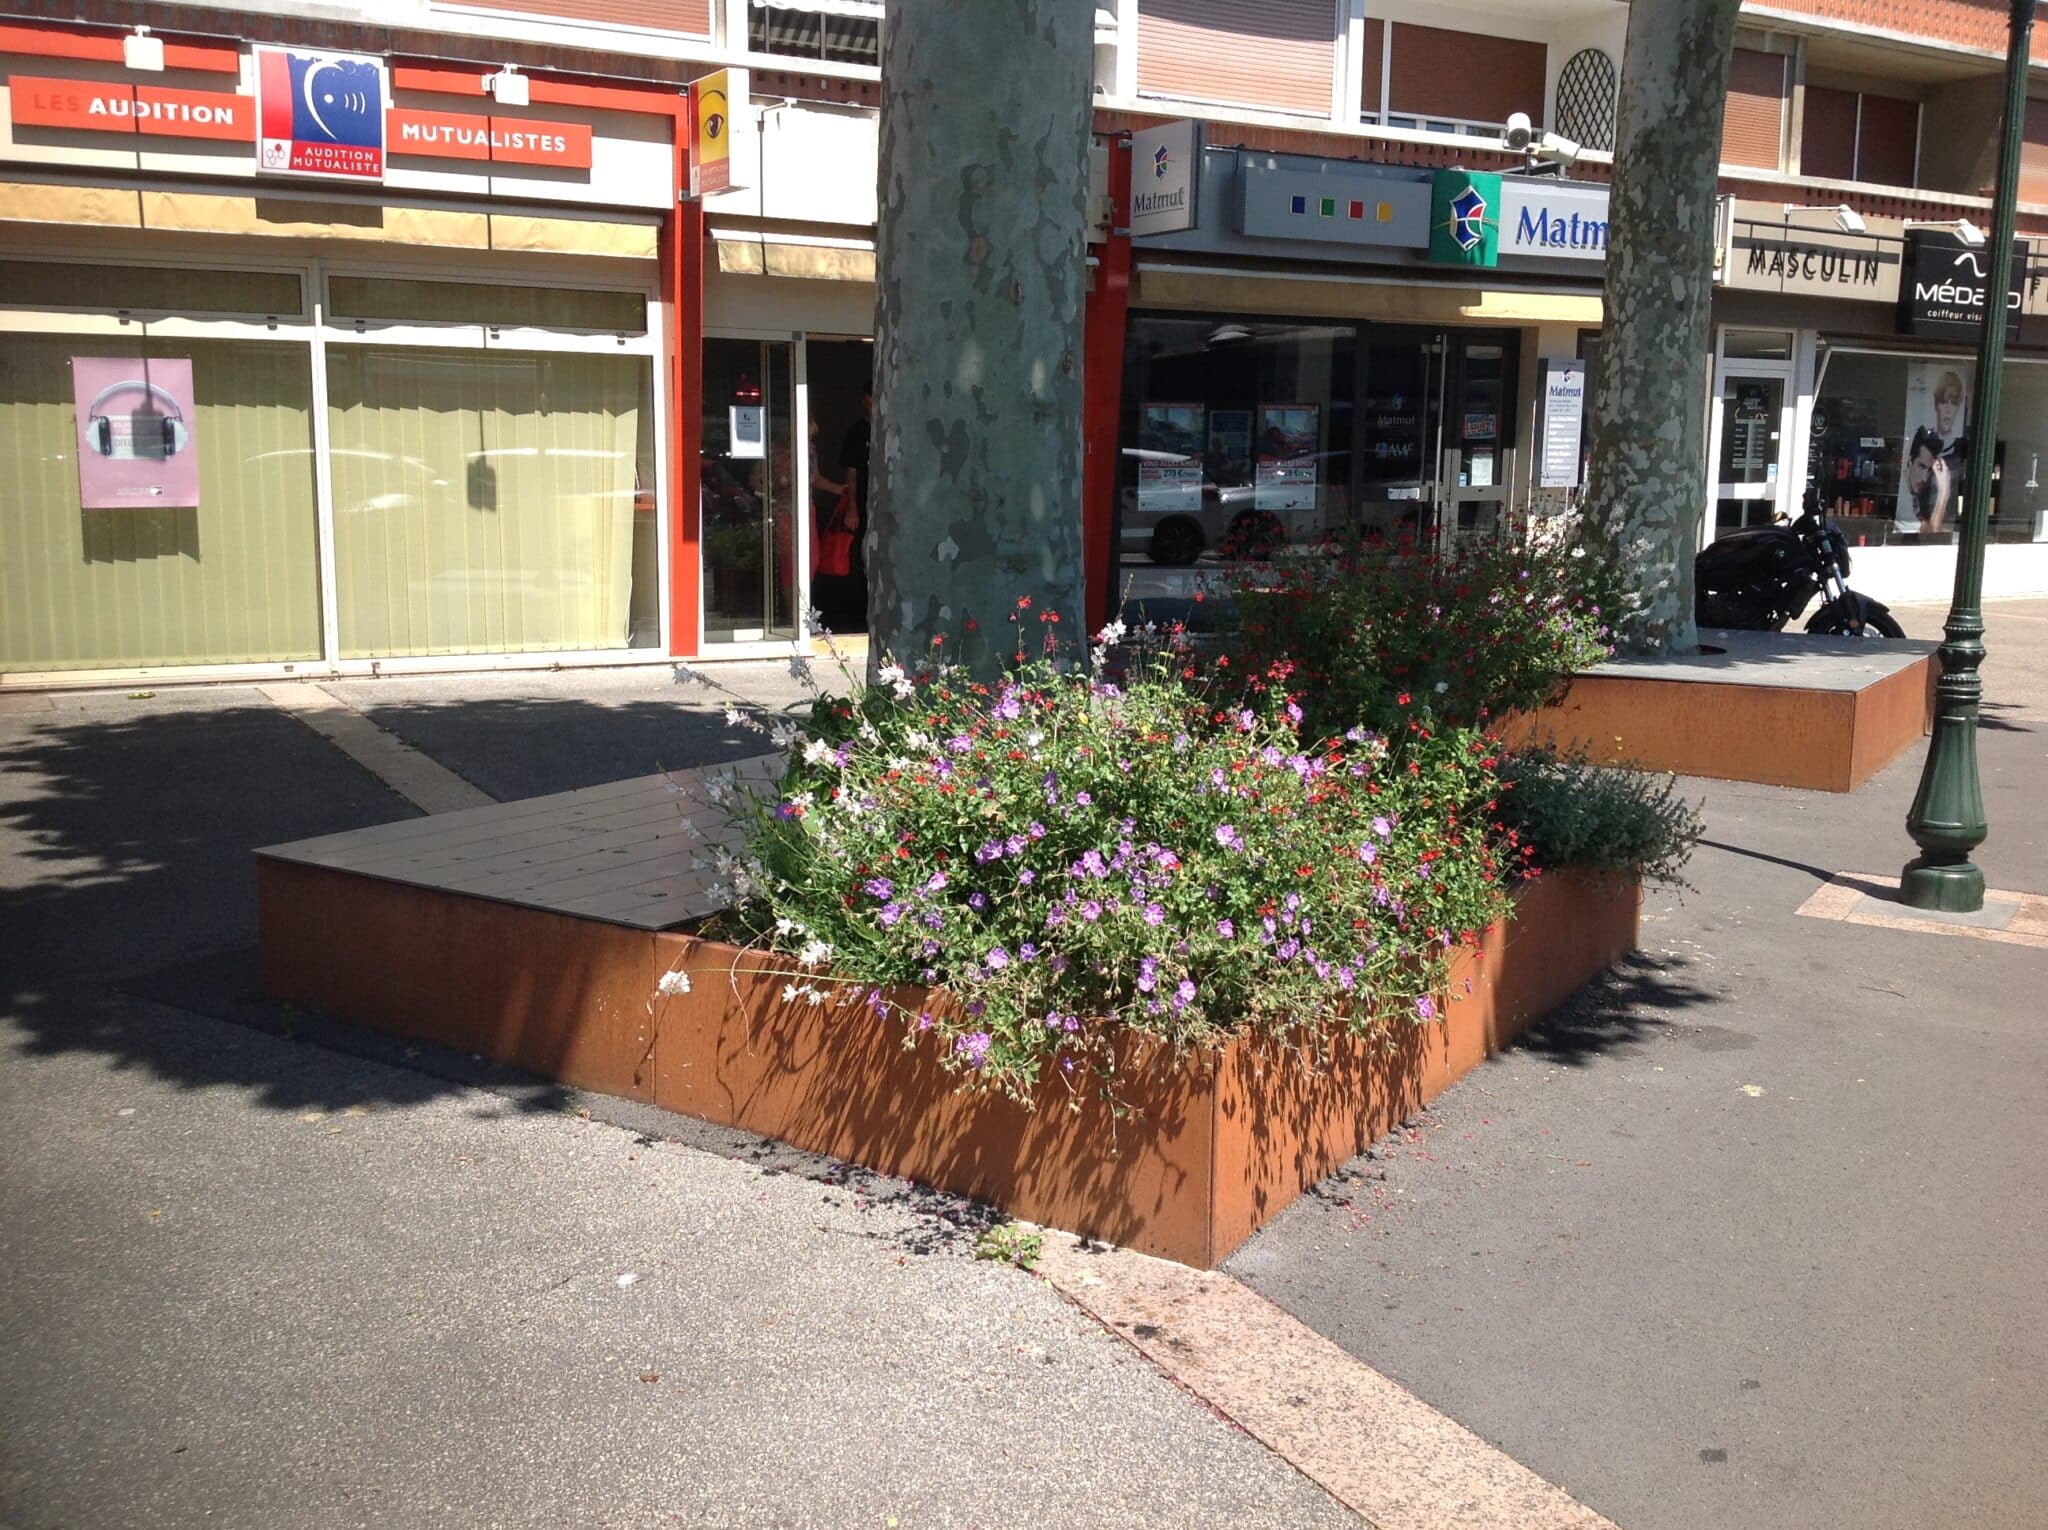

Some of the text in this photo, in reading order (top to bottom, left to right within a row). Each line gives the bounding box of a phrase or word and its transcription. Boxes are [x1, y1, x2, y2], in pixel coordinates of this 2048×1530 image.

[88, 97, 234, 125] AUDITION
[402, 123, 567, 153] MUTUALISTES
[293, 156, 380, 173] MUTUALISTE
[304, 146, 374, 162] AUDITION
[1133, 186, 1184, 213] Matmut
[1515, 206, 1610, 250] Matm
[1747, 245, 1879, 284] MASCULIN
[1927, 309, 1963, 320] coiffeur
[1549, 385, 1582, 397] Matmut
[1376, 415, 1416, 425] Matmut
